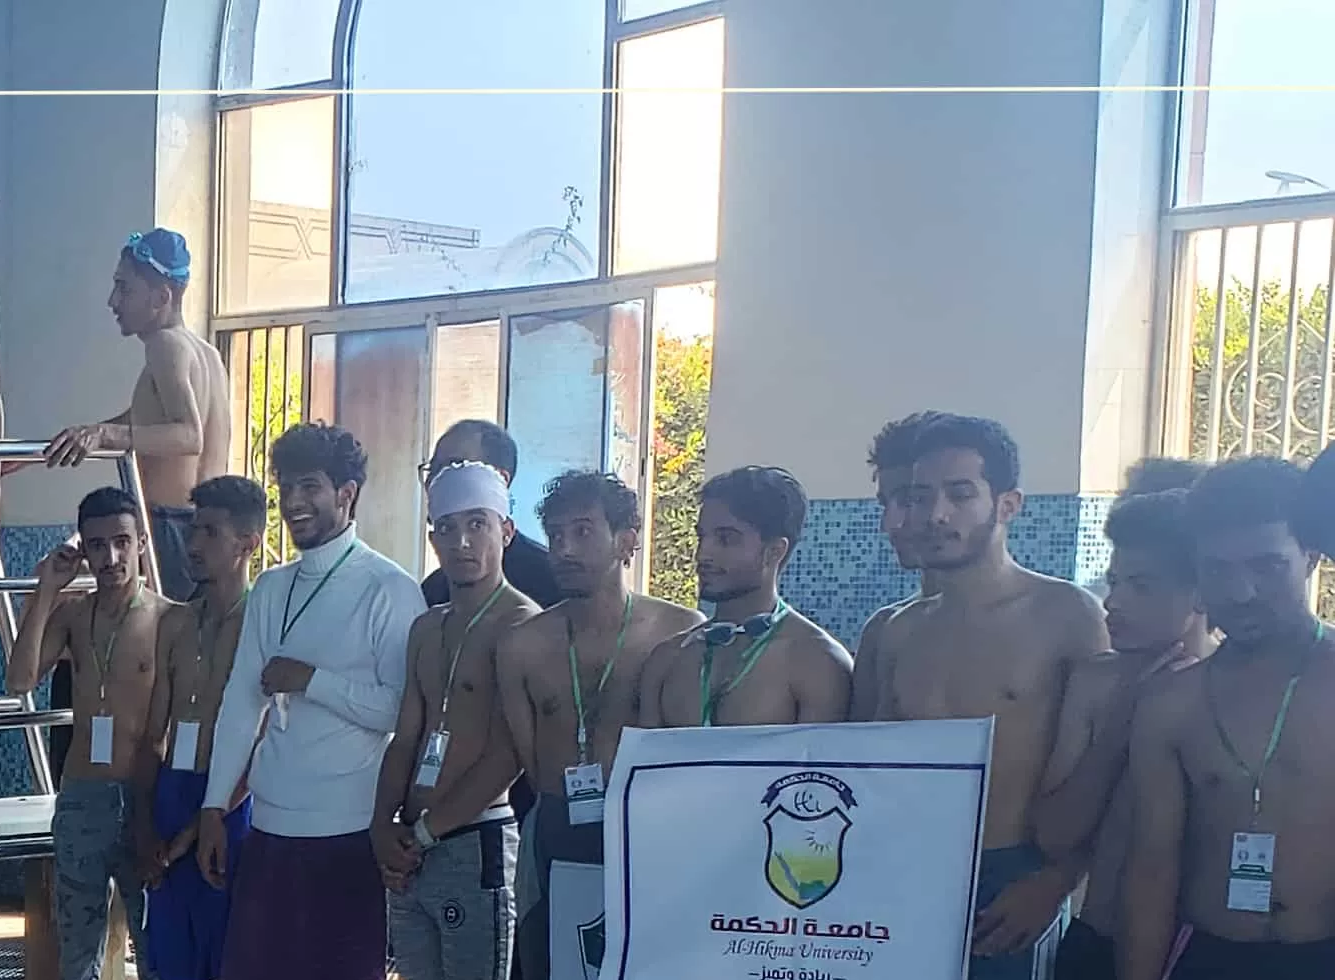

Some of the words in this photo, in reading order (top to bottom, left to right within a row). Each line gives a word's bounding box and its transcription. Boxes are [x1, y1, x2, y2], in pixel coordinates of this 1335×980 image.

[710, 913, 797, 936] الحكمة
[803, 918, 890, 943] جامعة
[723, 938, 795, 960] Al-Hikma
[799, 942, 874, 967] University
